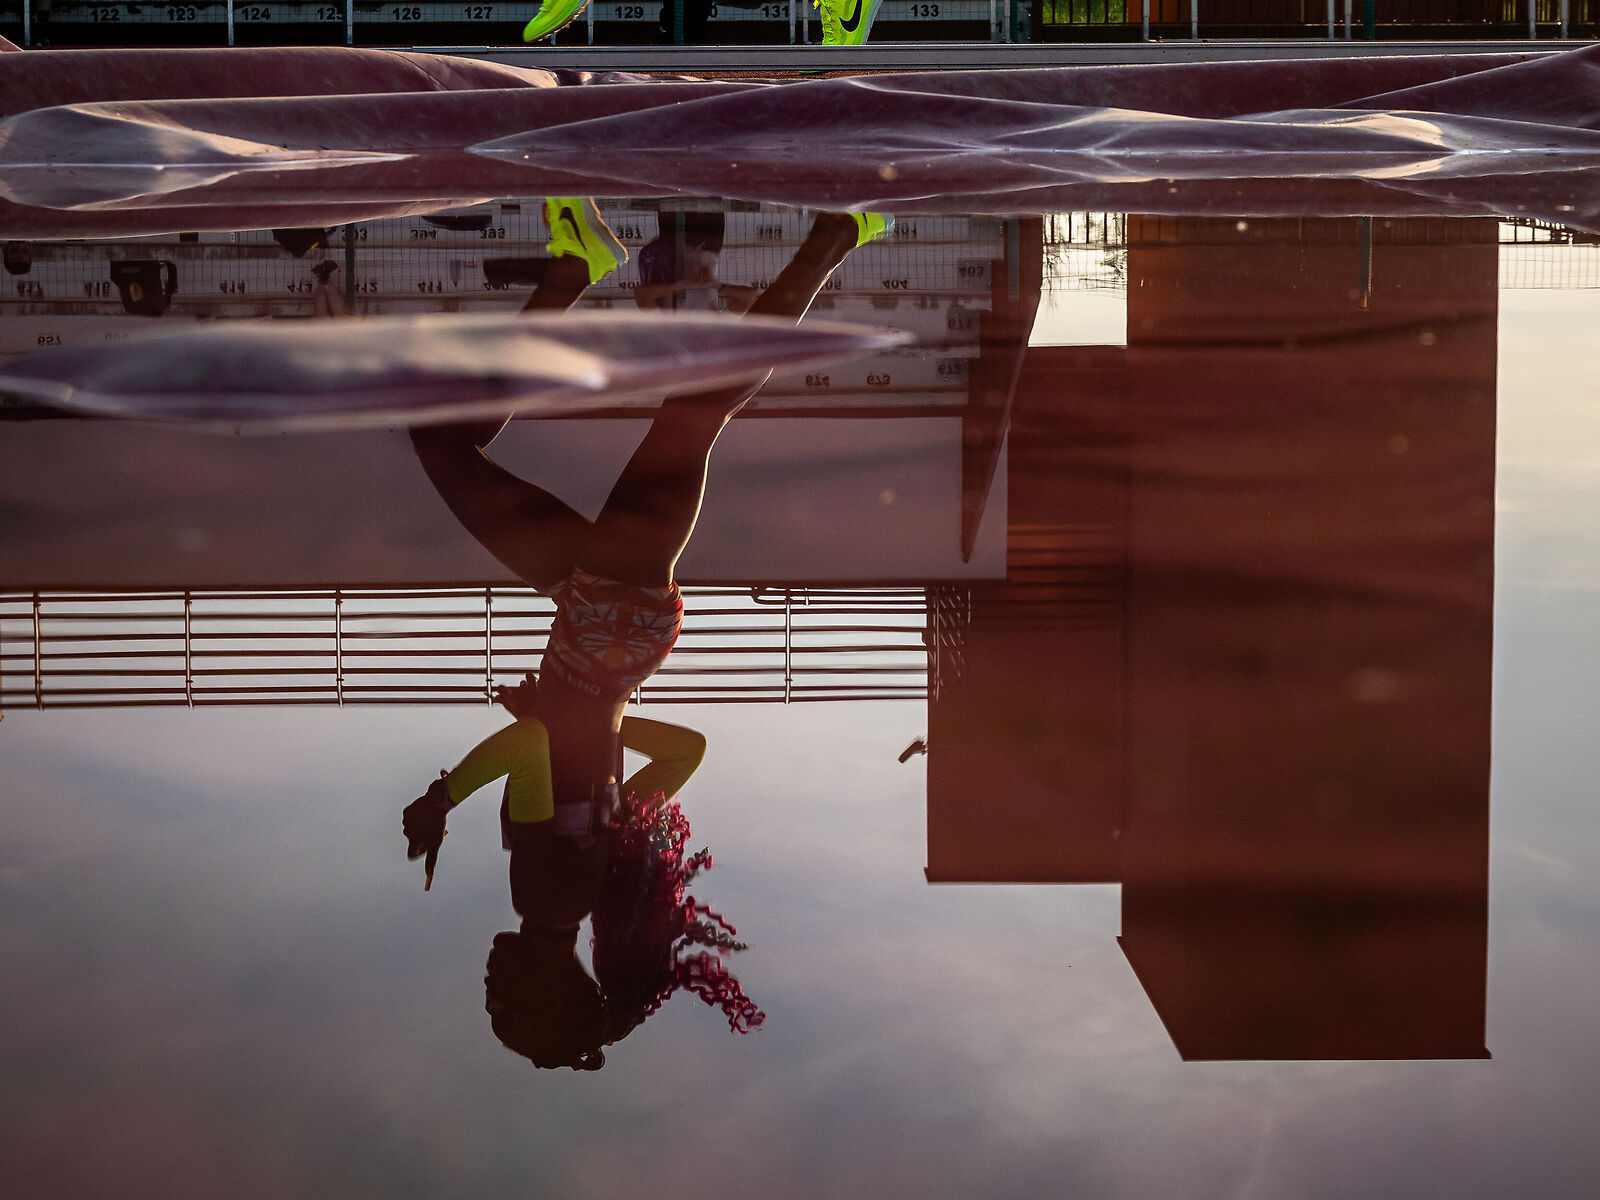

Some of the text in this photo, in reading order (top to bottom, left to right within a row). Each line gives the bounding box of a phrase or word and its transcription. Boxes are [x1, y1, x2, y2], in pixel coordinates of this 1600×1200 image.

[92, 8, 120, 21] 122
[168, 7, 196, 20] 123
[241, 7, 271, 20] 124
[393, 7, 421, 20] 126
[464, 6, 493, 19] 127
[615, 6, 644, 19] 129
[762, 5, 789, 18] 131
[911, 4, 939, 17] 133
